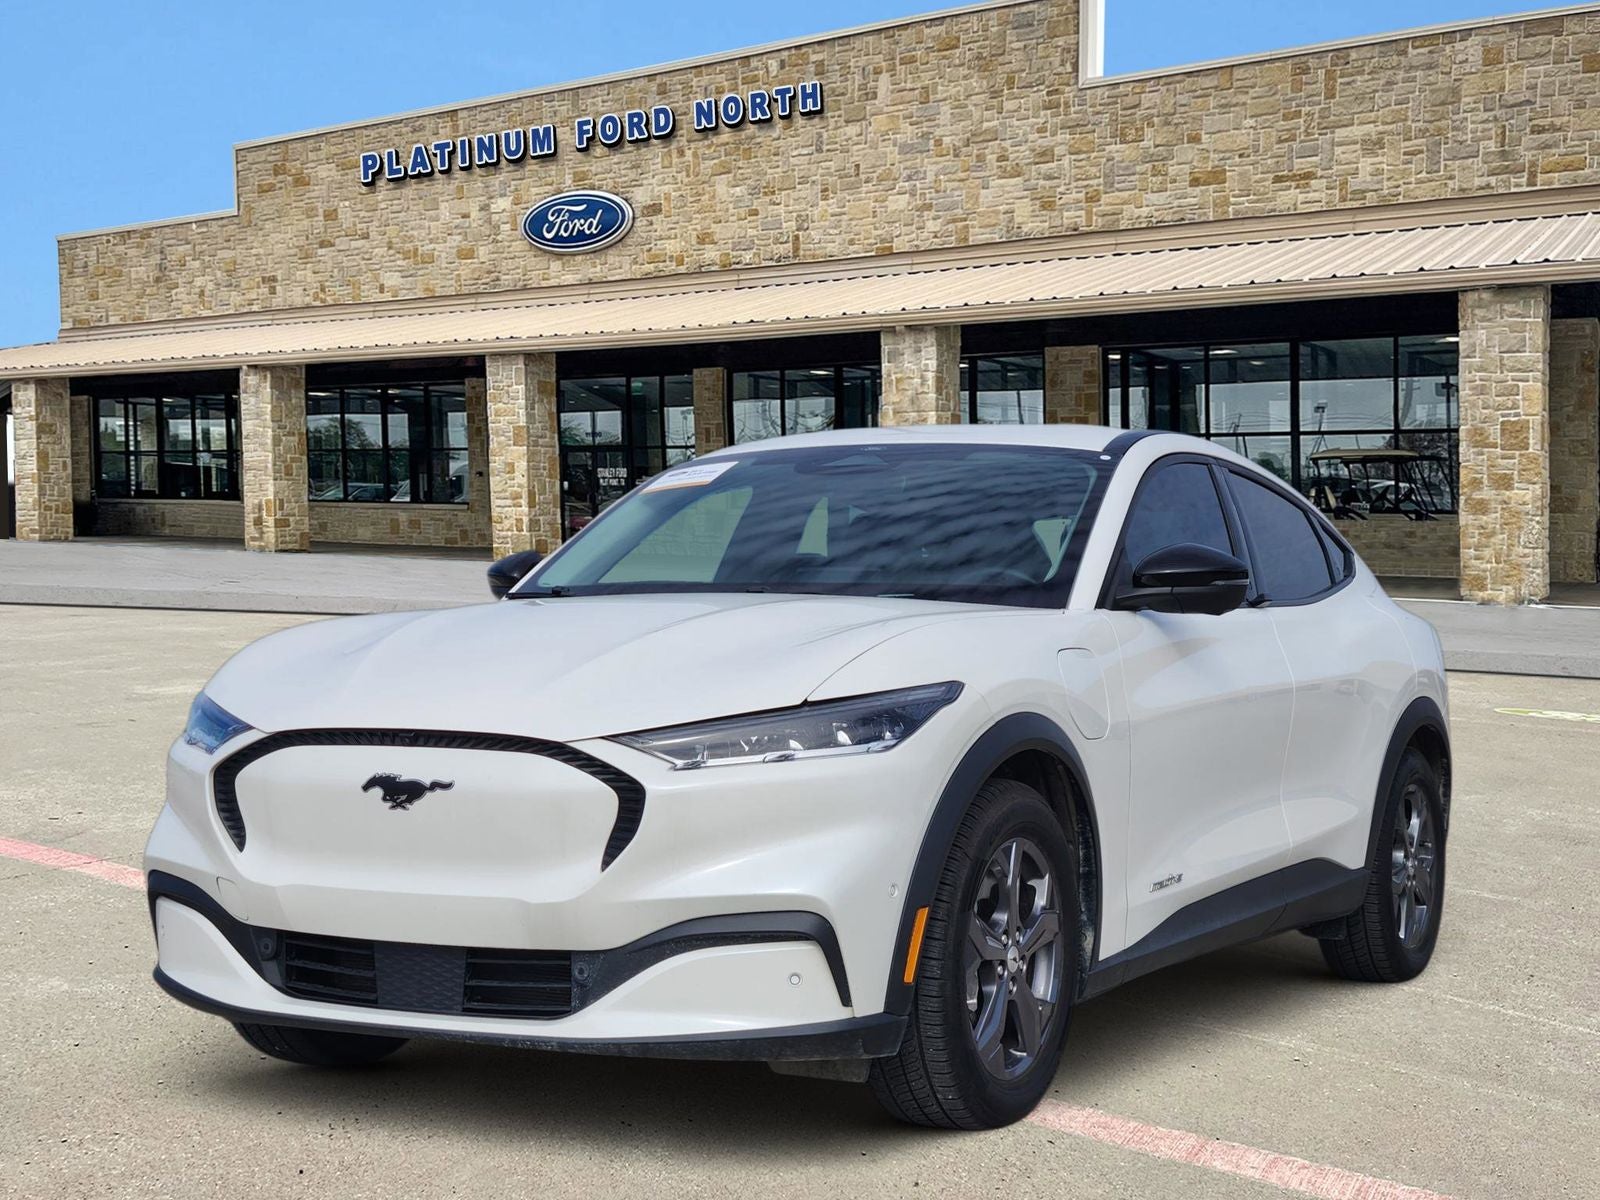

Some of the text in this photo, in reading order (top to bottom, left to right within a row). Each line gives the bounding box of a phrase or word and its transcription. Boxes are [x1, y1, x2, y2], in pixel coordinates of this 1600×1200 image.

[360, 81, 822, 184] PLATINUM FORD NORTH
[542, 203, 603, 239] Ford
